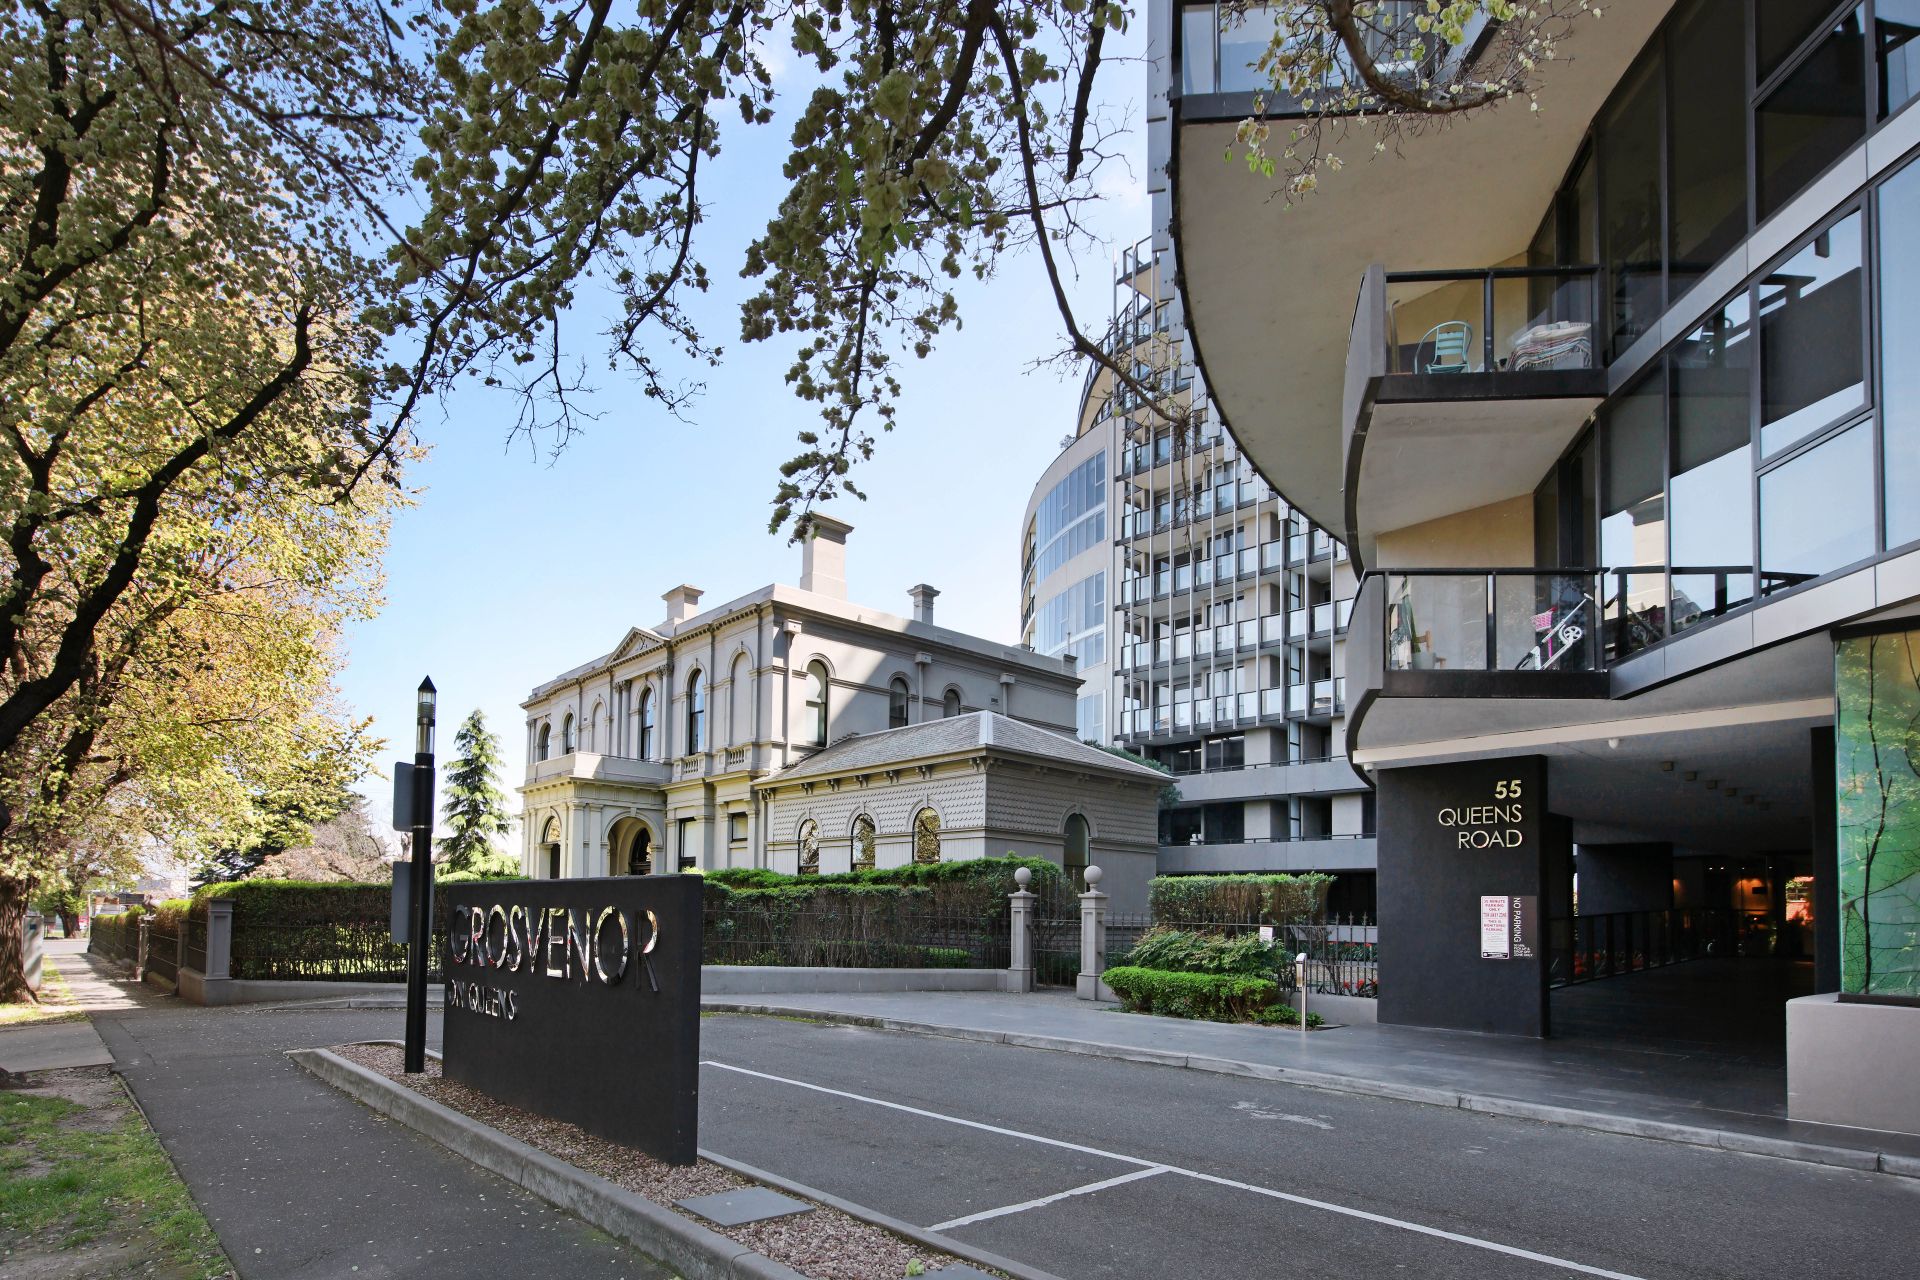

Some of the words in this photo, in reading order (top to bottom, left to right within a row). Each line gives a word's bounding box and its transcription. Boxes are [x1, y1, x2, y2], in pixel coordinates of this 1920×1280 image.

[1495, 779, 1522, 799] 55
[1438, 804, 1523, 827] QUEENS
[1458, 829, 1523, 849] ROAD
[1513, 897, 1521, 909] NO
[1513, 910, 1522, 943] PARKING
[450, 904, 661, 992] GROSVENOR
[468, 981, 518, 1021] QUEENS
